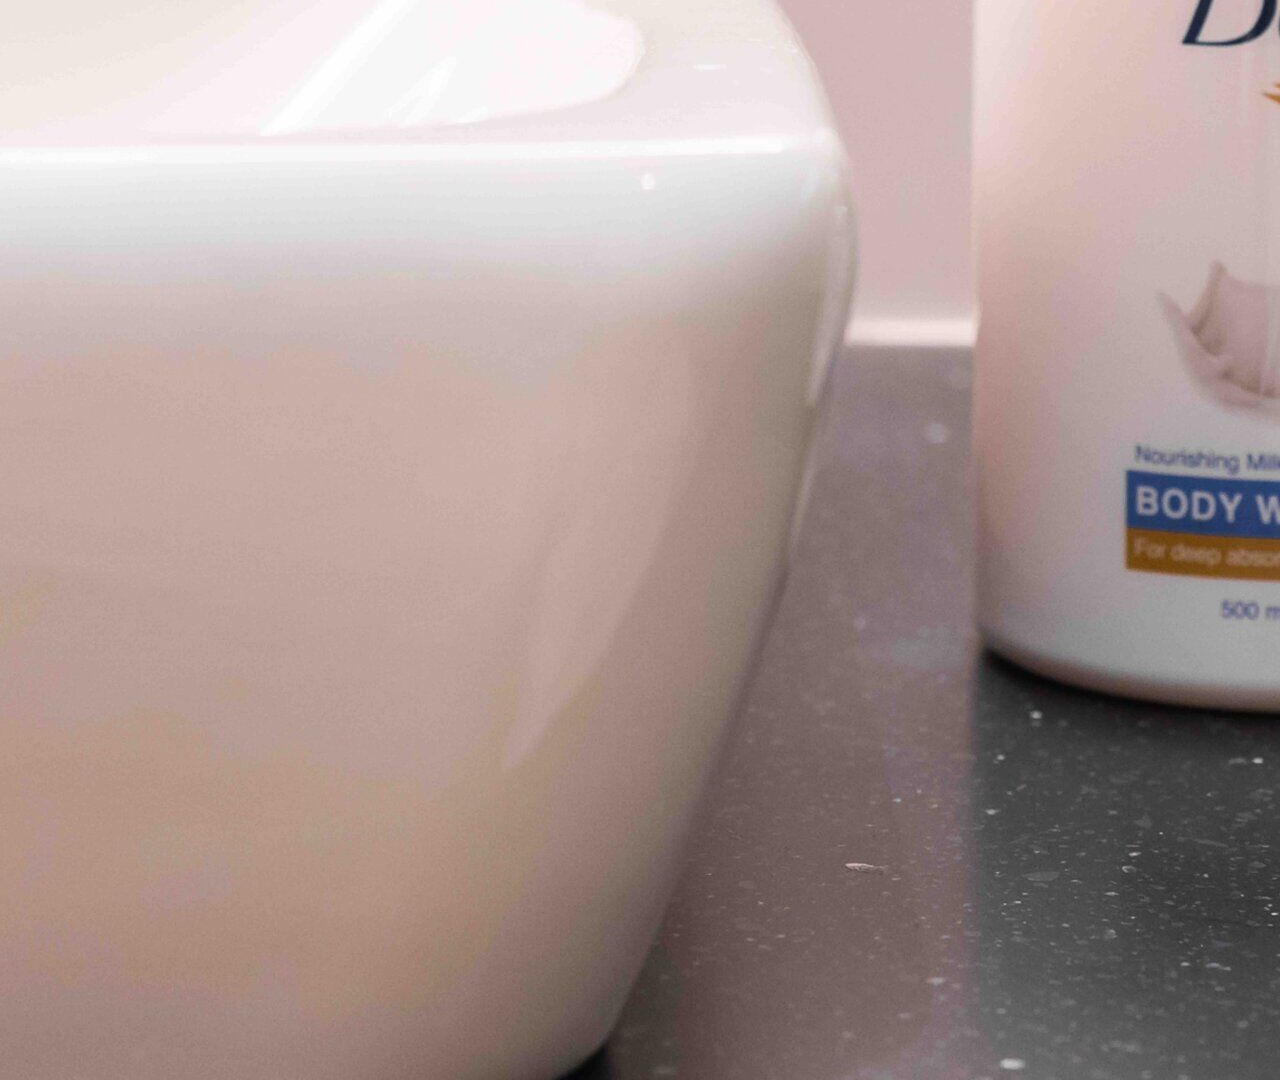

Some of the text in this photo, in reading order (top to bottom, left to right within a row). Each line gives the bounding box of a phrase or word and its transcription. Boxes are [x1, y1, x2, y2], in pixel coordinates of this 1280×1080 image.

[1135, 445, 1241, 475] Nourishing
[1136, 485, 1243, 523] BODY
[1133, 536, 1167, 560] For
[1170, 543, 1222, 567] deep
[1221, 599, 1260, 619] 500
